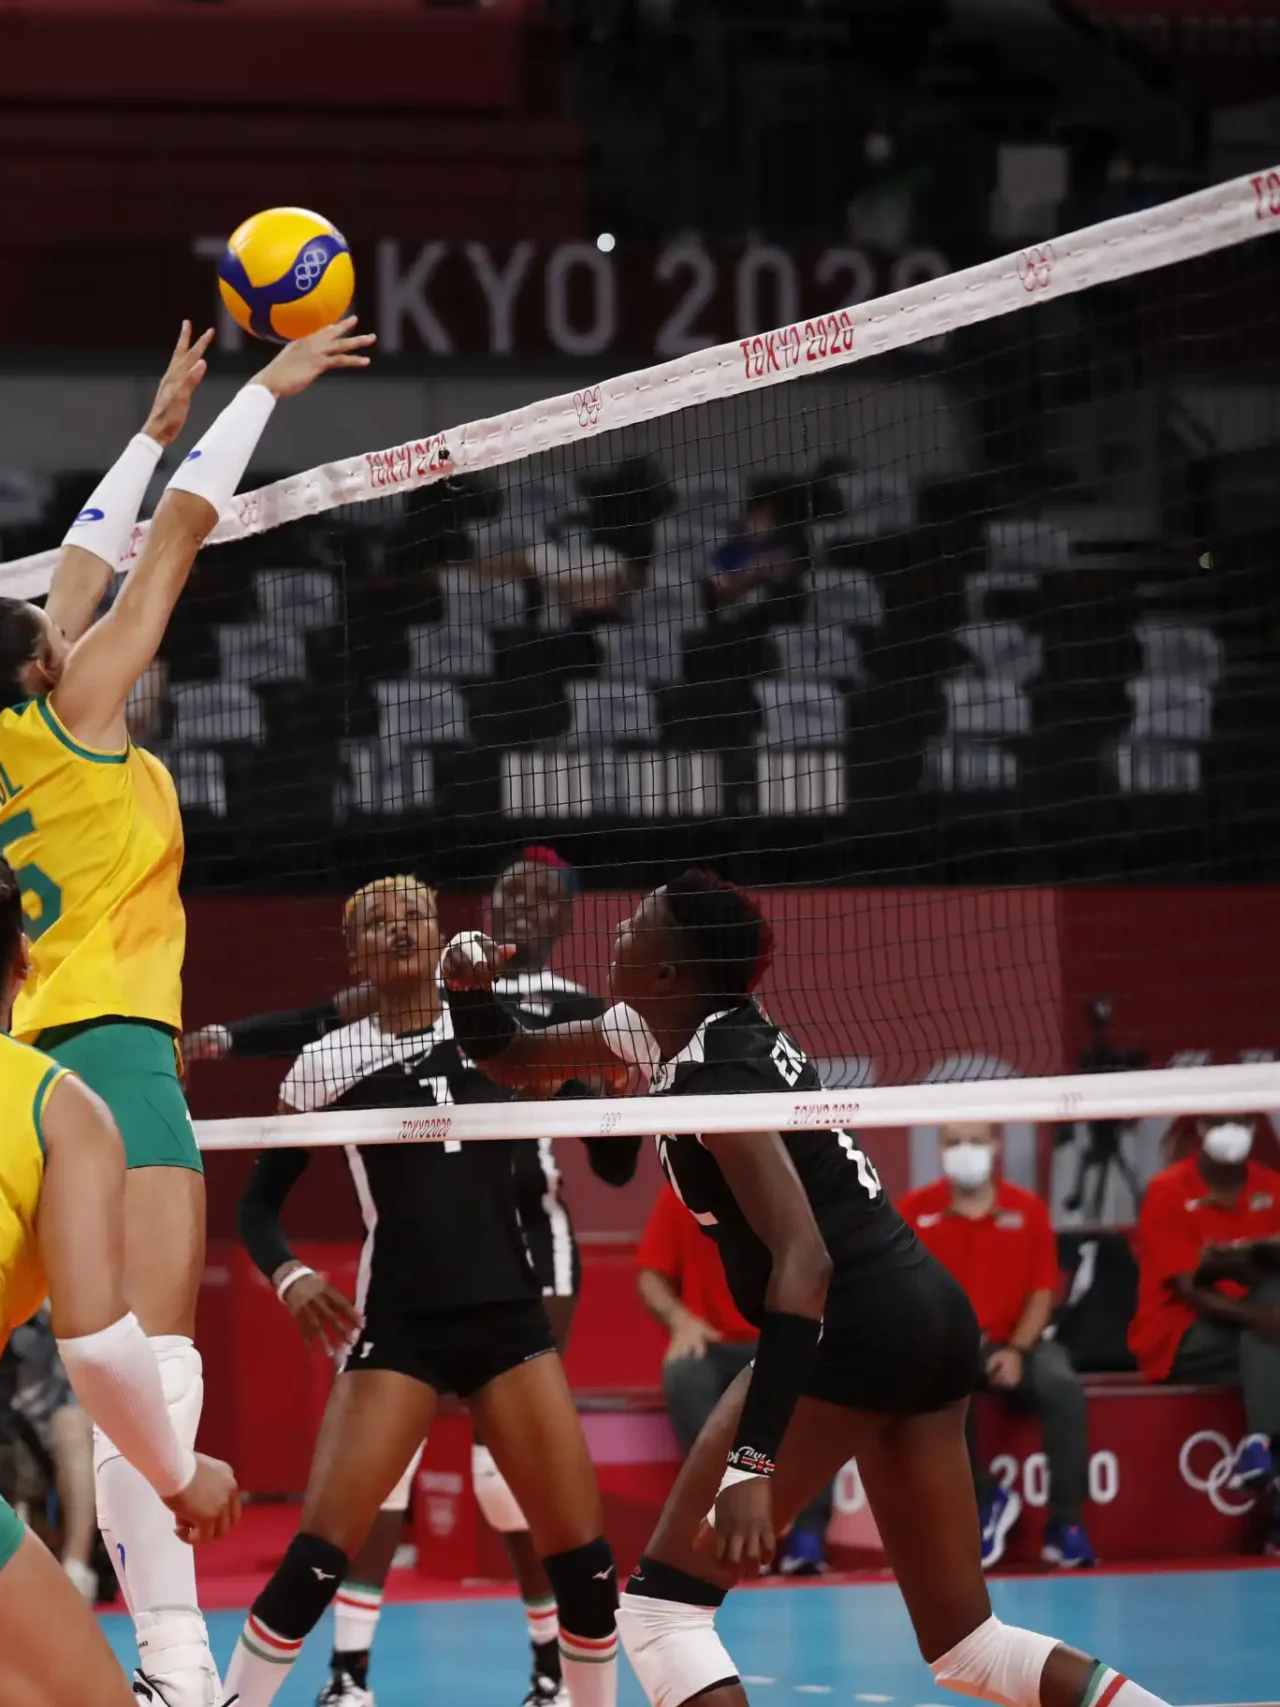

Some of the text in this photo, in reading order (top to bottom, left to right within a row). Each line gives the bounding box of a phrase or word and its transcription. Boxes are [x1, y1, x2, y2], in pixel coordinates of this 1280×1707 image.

[739, 311, 854, 379] TOKYO 2020
[989, 1450, 1119, 1507] 200
